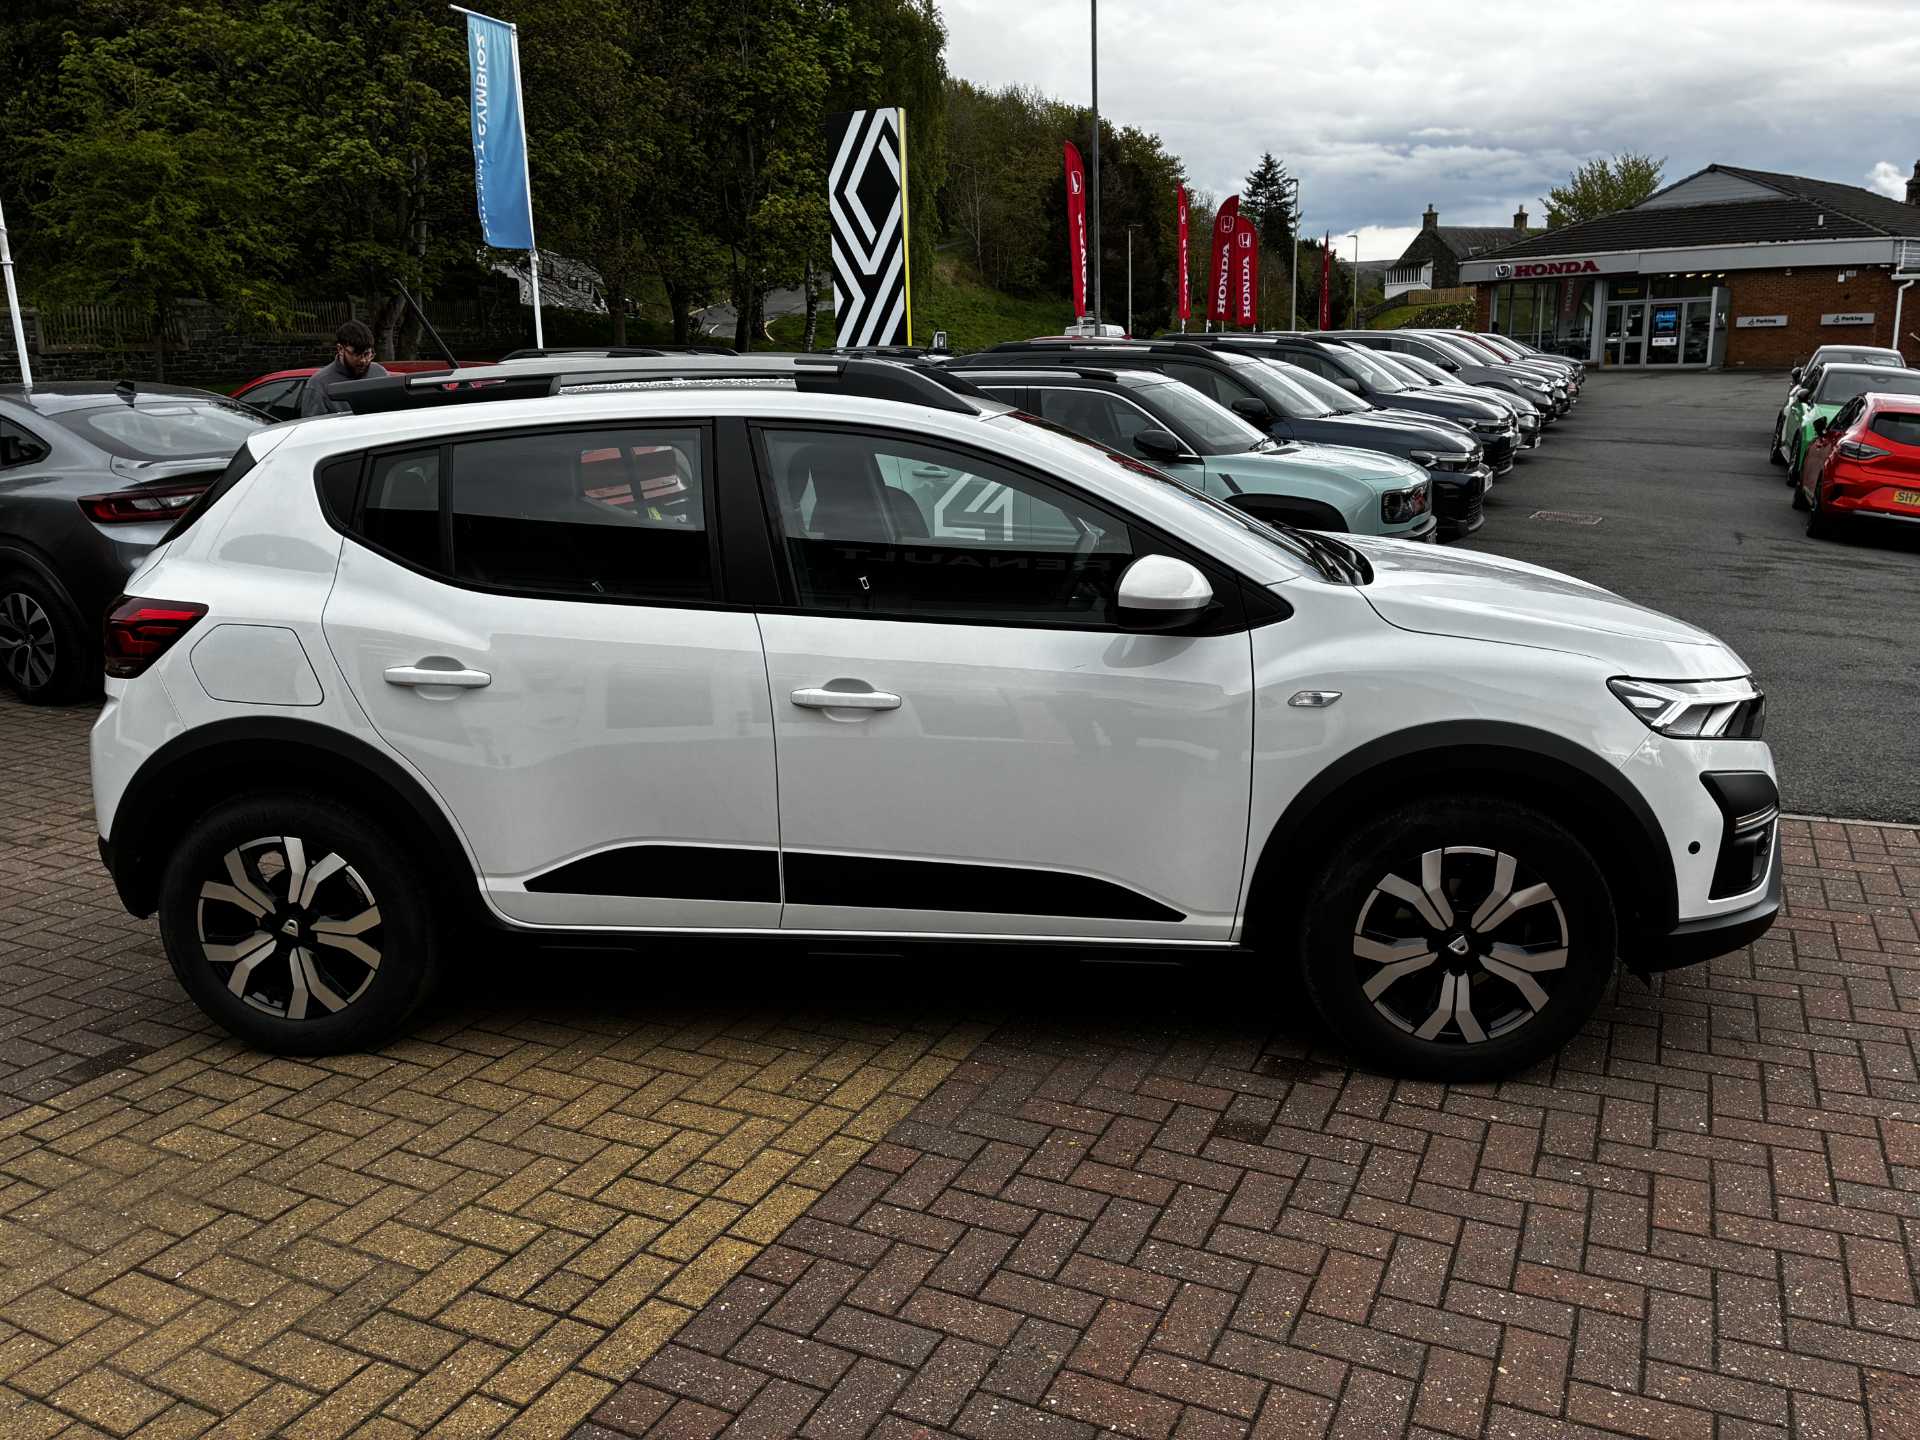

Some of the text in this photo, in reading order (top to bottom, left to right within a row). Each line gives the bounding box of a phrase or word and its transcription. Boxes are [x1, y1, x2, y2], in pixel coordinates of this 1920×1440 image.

[1514, 261, 1599, 277] HONDA
[1217, 242, 1230, 314] HONDA
[1242, 256, 1251, 318] HONDA
[1756, 316, 1777, 324] Parking
[1841, 313, 1864, 322] Parking
